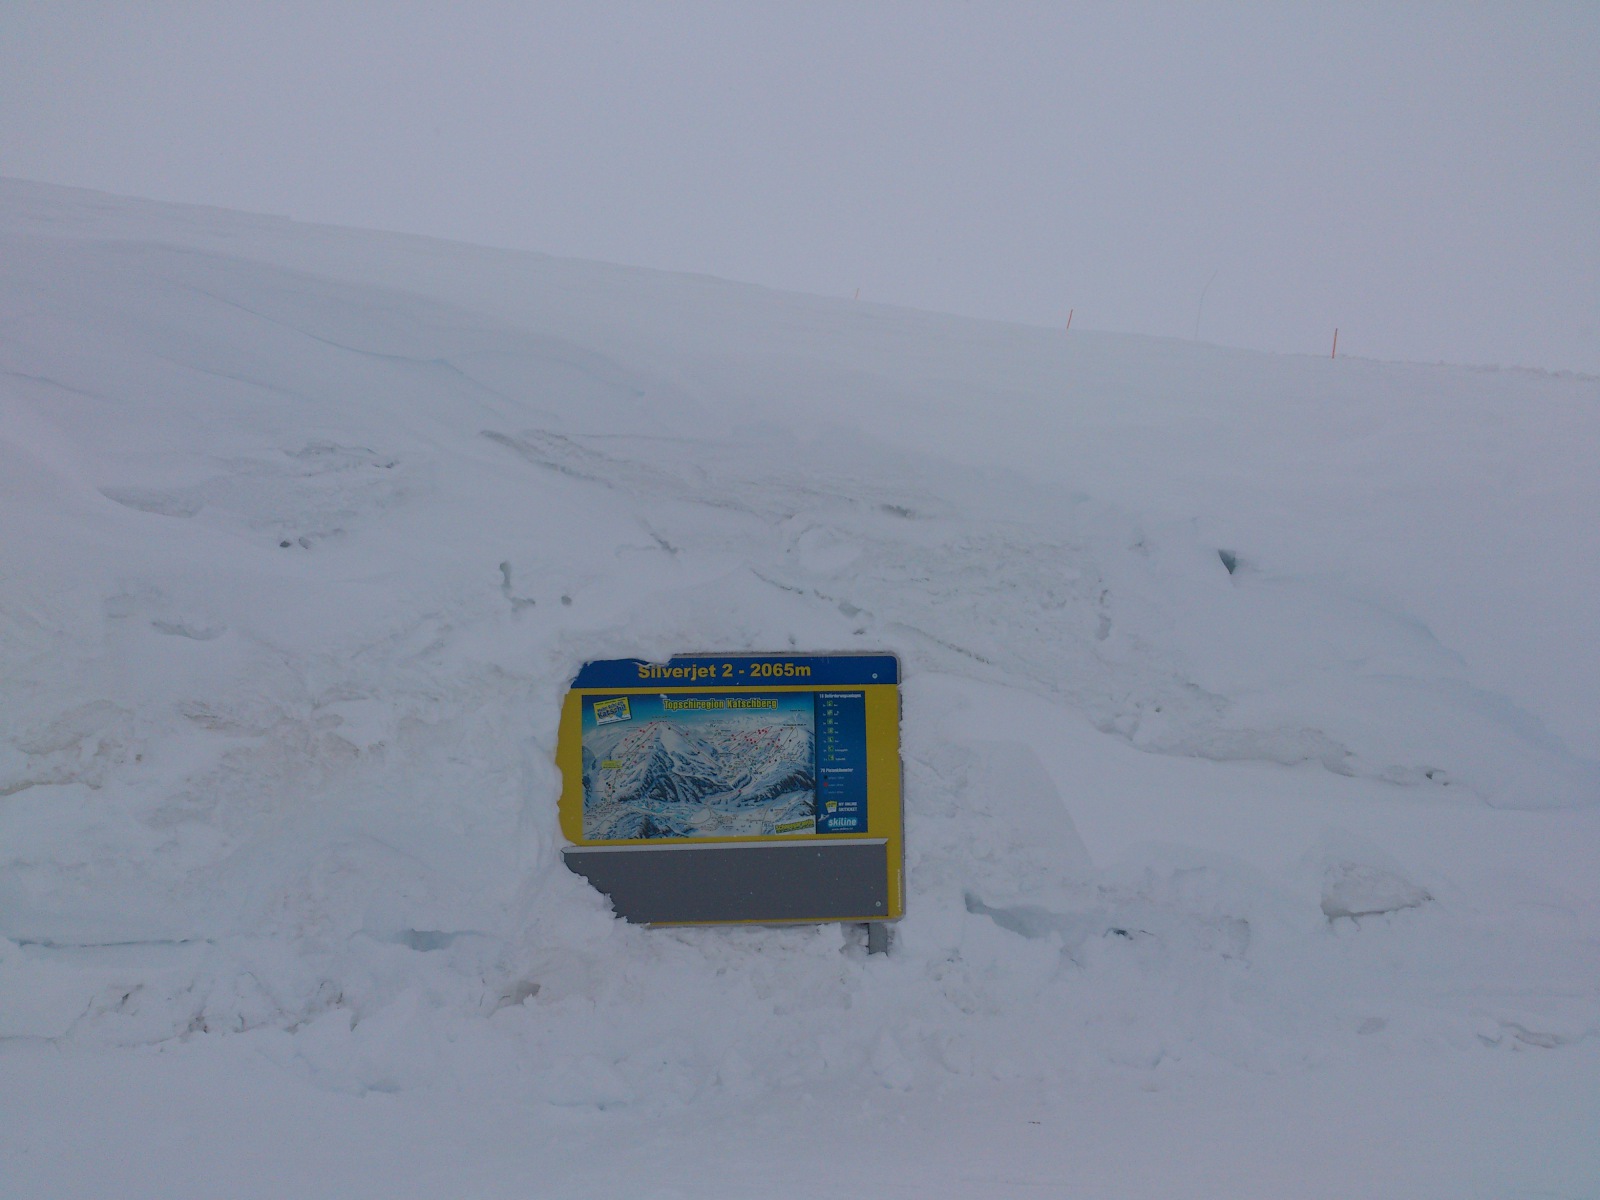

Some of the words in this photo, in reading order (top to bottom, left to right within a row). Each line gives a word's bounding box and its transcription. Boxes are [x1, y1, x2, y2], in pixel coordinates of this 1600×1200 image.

[638, 663, 716, 681] Silverjet
[722, 663, 733, 677] 2
[750, 663, 811, 677] 2065m
[663, 698, 725, 712] Topschiregion
[726, 697, 778, 711] Katschberg
[828, 817, 857, 826] skiline
